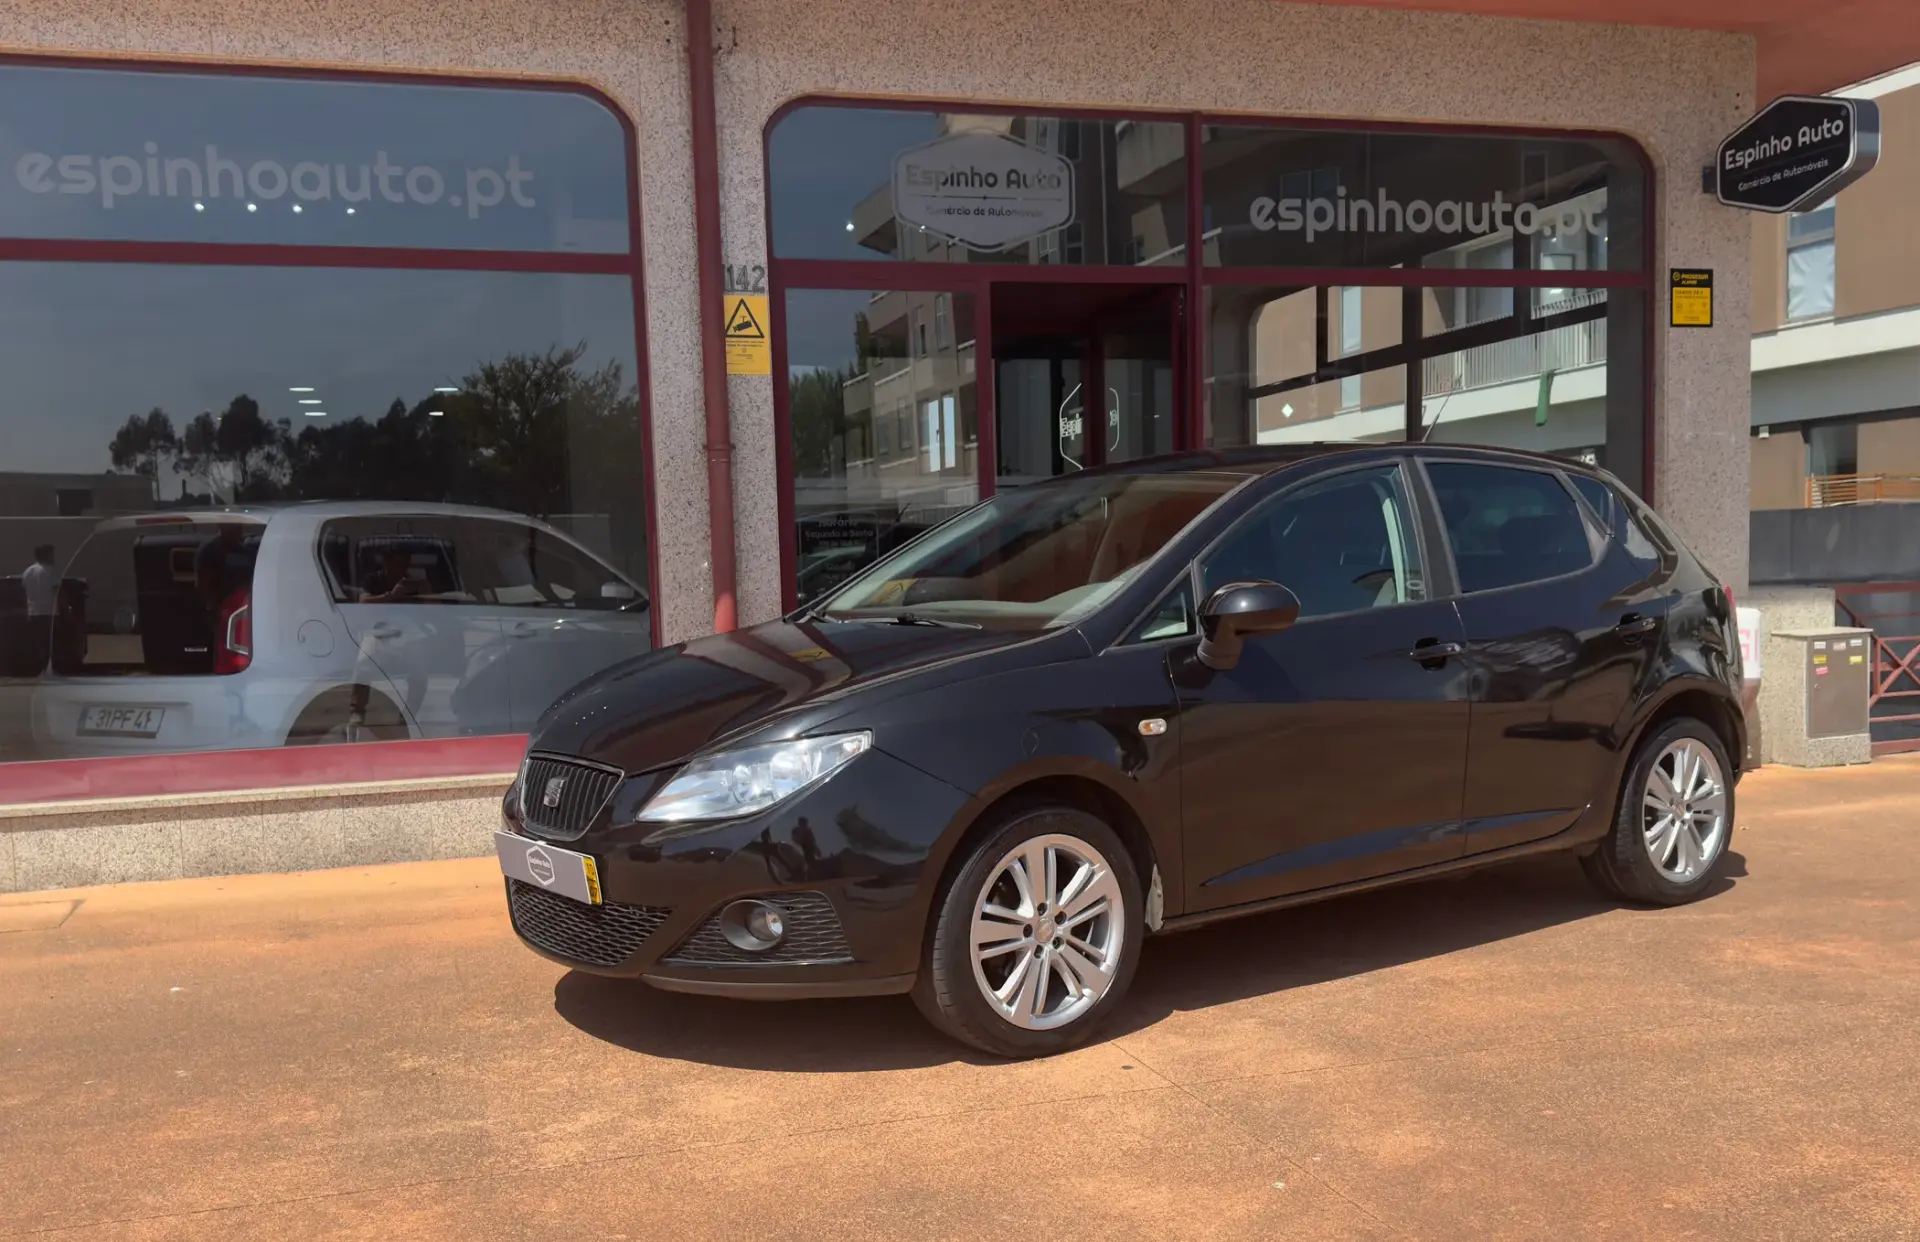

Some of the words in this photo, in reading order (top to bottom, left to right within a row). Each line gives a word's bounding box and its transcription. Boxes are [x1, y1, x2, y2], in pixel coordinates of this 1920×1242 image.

[1725, 136, 1792, 170] Espinho
[1798, 119, 1844, 147] Auto
[15, 141, 536, 219] espinhoauto.pt
[906, 165, 998, 192] Espinho
[1006, 169, 1062, 190] Auto
[1772, 172, 1782, 182] de
[1783, 158, 1829, 178] Automóveis
[973, 205, 985, 216] de
[1250, 186, 1608, 244] espinhoauto.pt
[726, 264, 765, 293] 142
